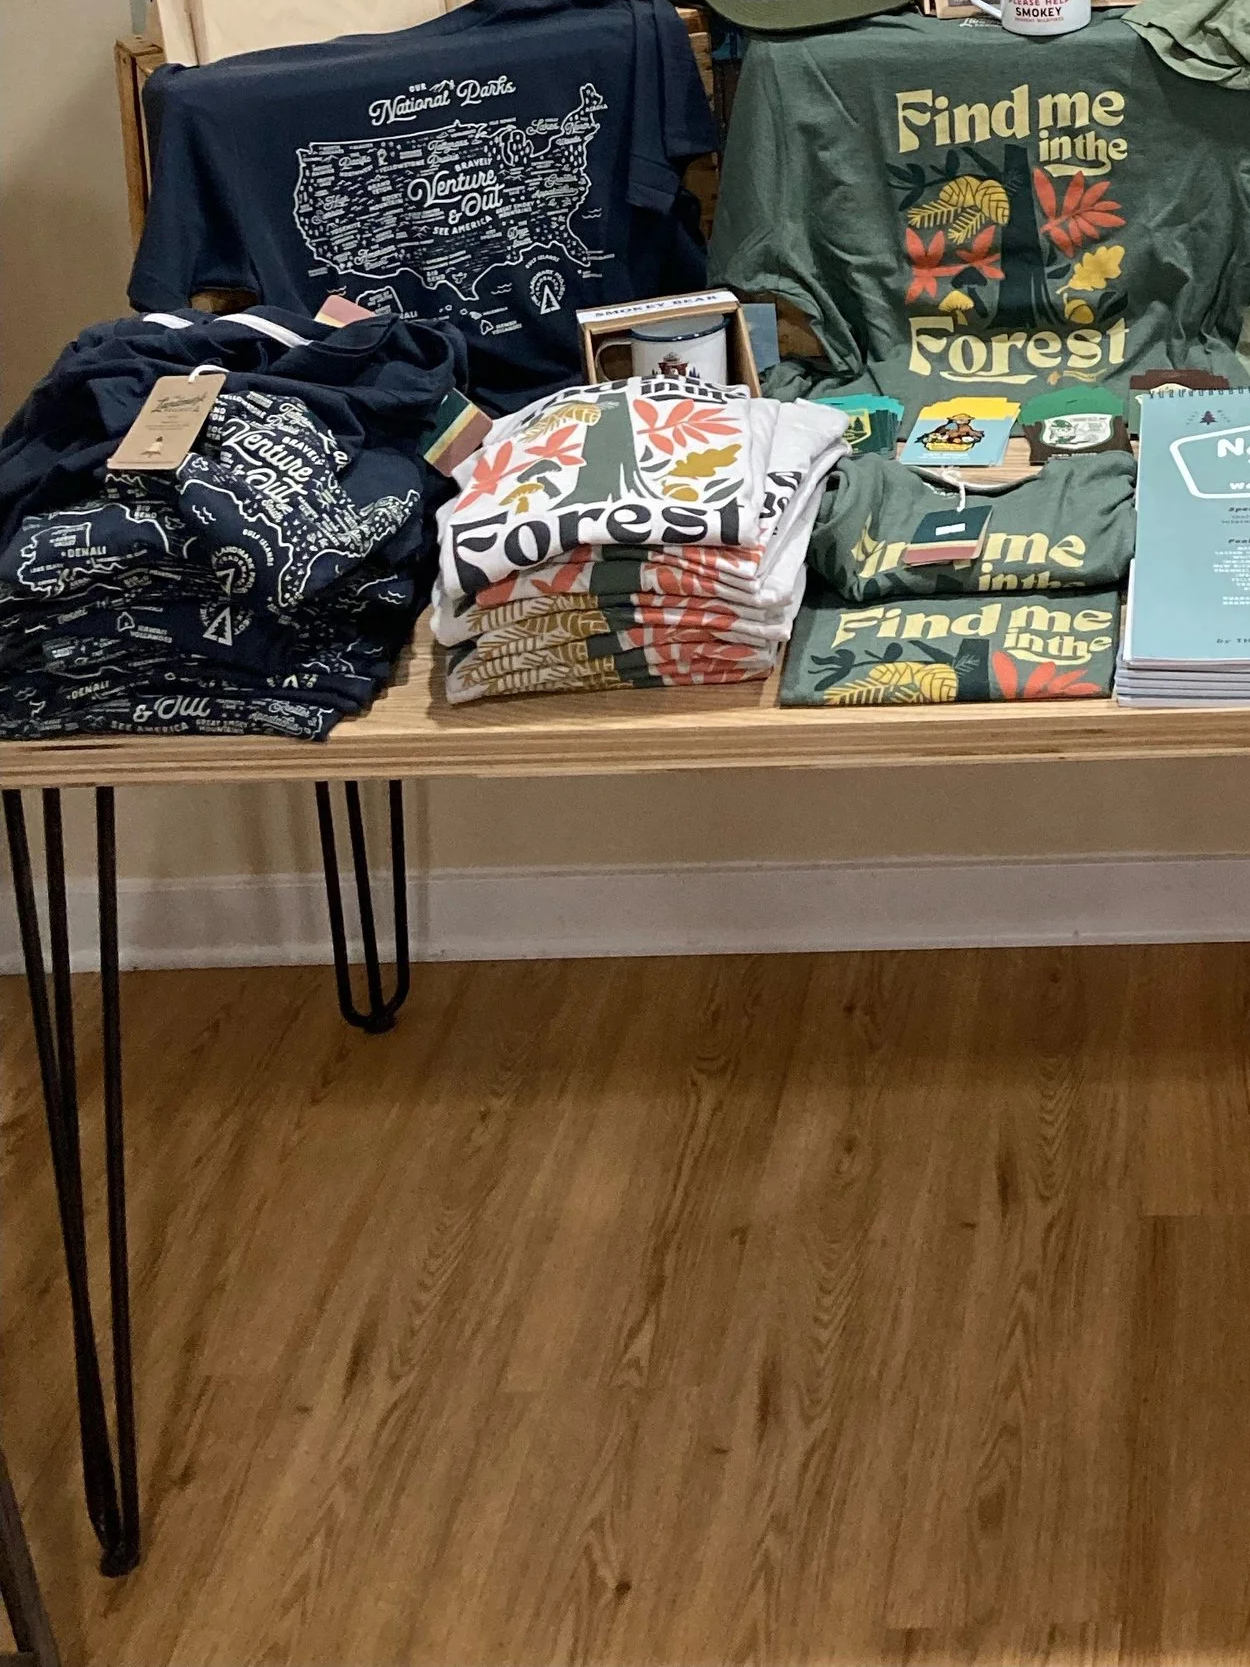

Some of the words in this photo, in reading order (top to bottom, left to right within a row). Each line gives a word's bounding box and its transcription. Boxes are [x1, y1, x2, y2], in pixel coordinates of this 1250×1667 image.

[1015, 7, 1063, 18] SMOKEY
[368, 91, 451, 126] National
[456, 75, 516, 107] Parks
[896, 84, 1029, 153] Find
[1038, 89, 1125, 128] me
[454, 158, 493, 172] BRAVELY
[407, 170, 497, 208] Venture
[461, 184, 505, 217] Out
[433, 226, 450, 235] SEE
[451, 215, 493, 235] AMERICA
[594, 302, 665, 318] SMOKEY
[673, 295, 717, 305] BEAR
[908, 317, 1130, 383] Forest
[222, 418, 313, 482] Venture
[282, 436, 326, 466] BRAVELY
[245, 468, 308, 504] Out
[67, 546, 107, 558] DENALI
[452, 499, 745, 596] Forest
[986, 532, 1087, 567] me
[831, 603, 1003, 648] Find
[1008, 605, 1113, 633] me
[71, 680, 110, 699] DENALI
